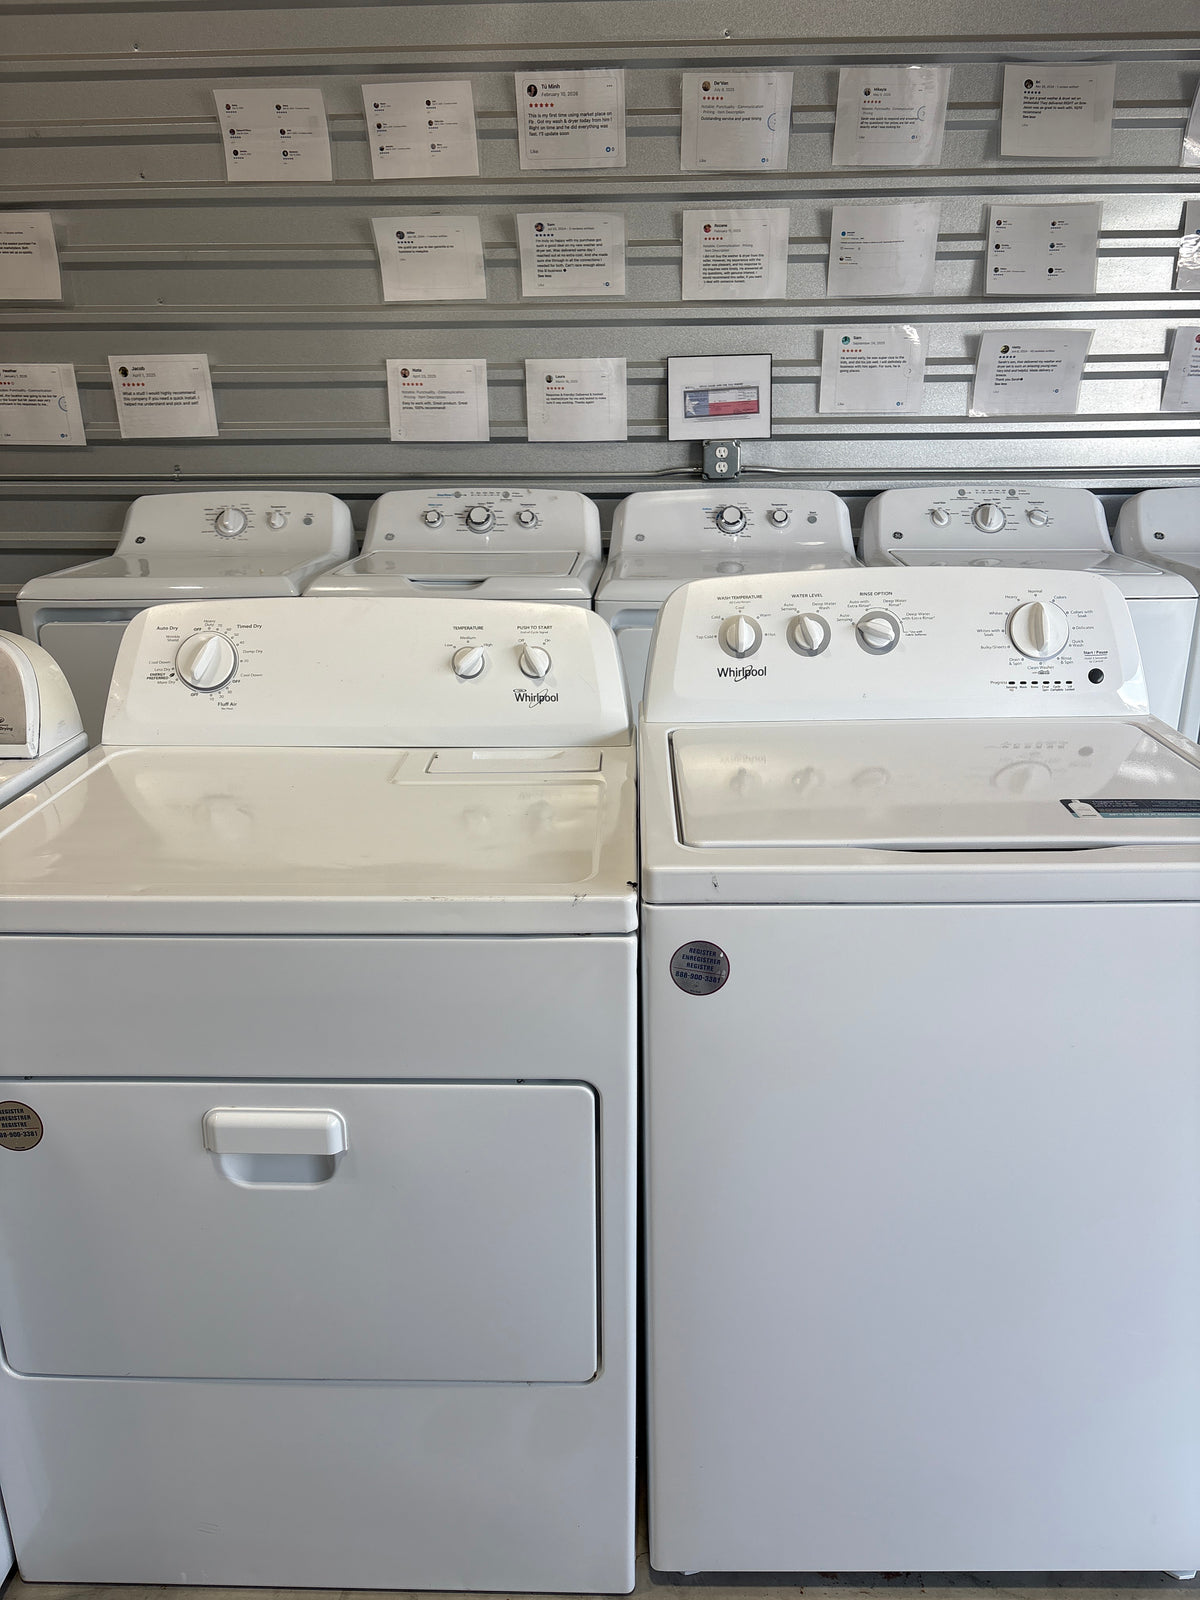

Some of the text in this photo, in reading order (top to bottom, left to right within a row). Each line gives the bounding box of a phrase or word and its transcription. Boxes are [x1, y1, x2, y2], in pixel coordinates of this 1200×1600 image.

[717, 666, 766, 679] Whirlpool
[515, 692, 558, 704] Whirlpool
[689, 948, 716, 956] REGISTER
[682, 954, 720, 965] ENREGISTRER
[687, 963, 714, 971] REGISTRE
[676, 971, 720, 983] 888-900-3381
